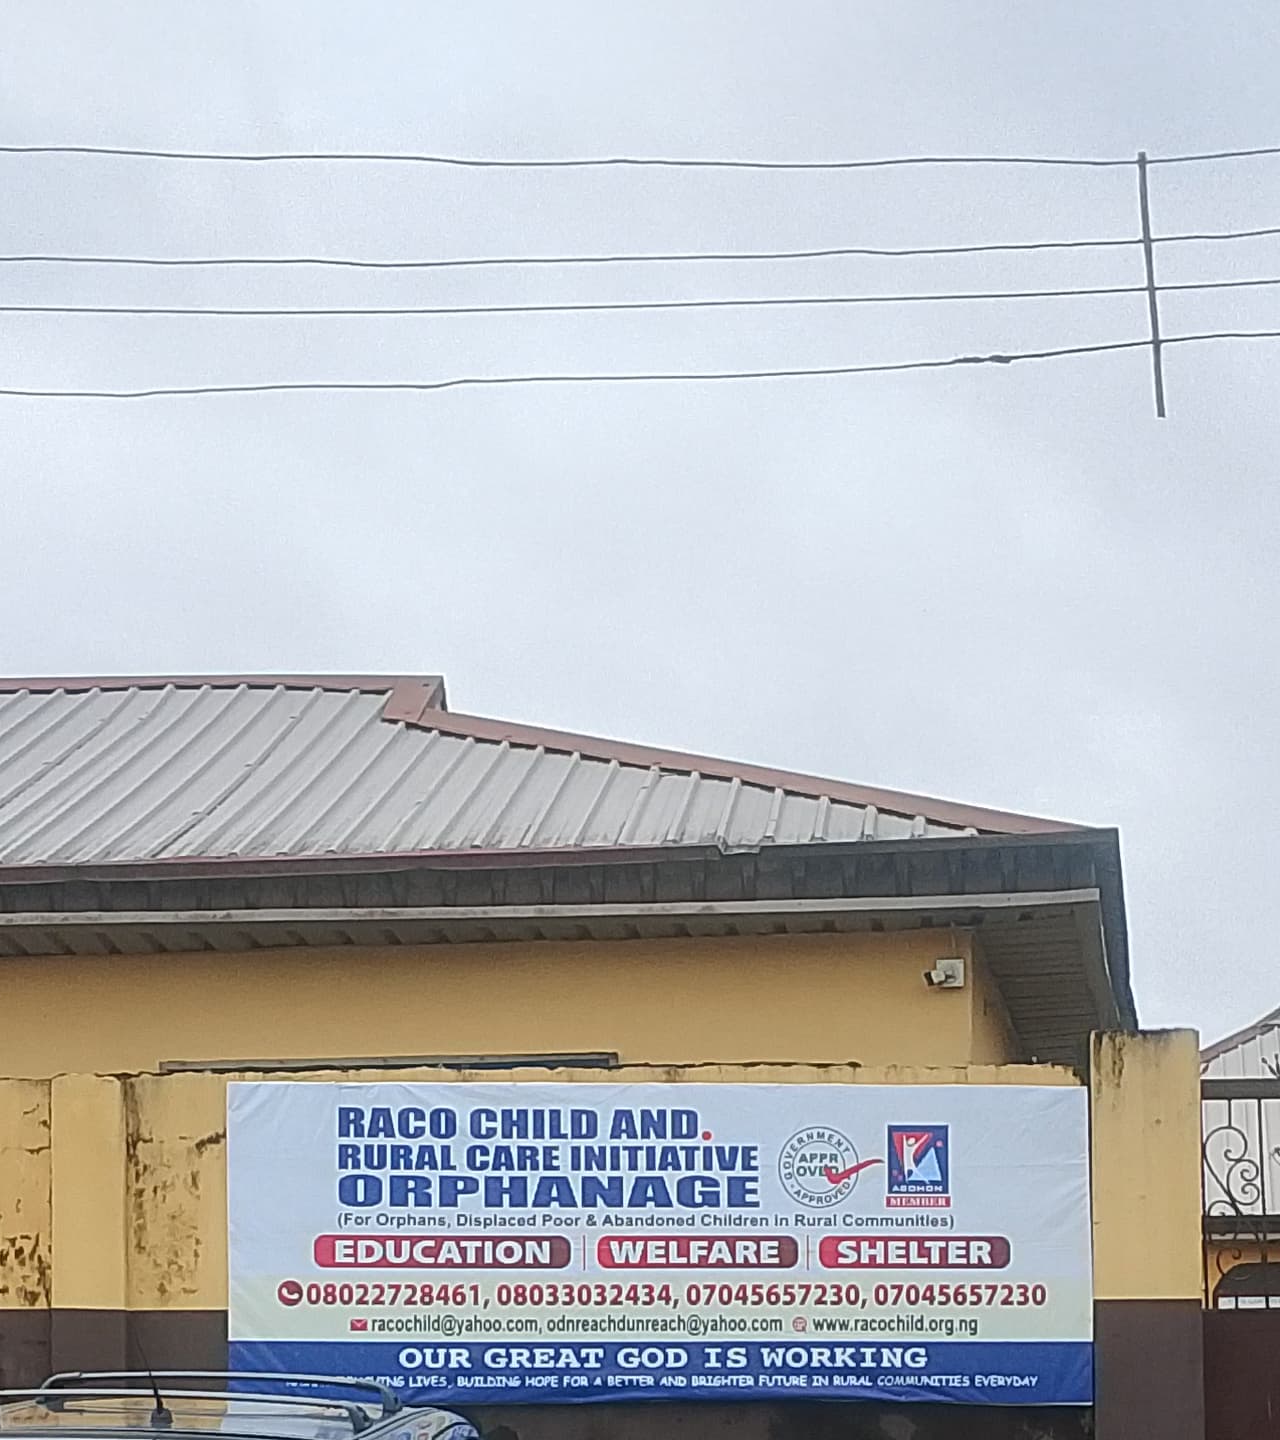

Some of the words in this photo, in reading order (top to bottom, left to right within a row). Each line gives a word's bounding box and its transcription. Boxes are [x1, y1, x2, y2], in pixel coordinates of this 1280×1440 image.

[337, 1106, 457, 1140] RACO
[469, 1107, 598, 1140] CHILD
[337, 1144, 457, 1171] RURAL
[466, 1144, 561, 1171] CARE
[569, 1145, 760, 1171] INITIATIVE
[783, 1131, 851, 1181] GOVERNMENT
[798, 1153, 840, 1164] APPR
[337, 1174, 761, 1208] ORPHANAGE
[889, 1197, 948, 1207] MEMBER
[337, 1213, 371, 1229] (For
[375, 1213, 452, 1230] Orphans,
[456, 1213, 537, 1229] Displaced
[541, 1214, 581, 1228] Poor
[585, 1214, 598, 1228] &
[602, 1214, 696, 1228] Abandoned
[700, 1214, 769, 1227] Children
[794, 1214, 838, 1227] Rural
[842, 1213, 955, 1230] Communities)
[333, 1239, 552, 1265] EDUCATION
[608, 1240, 780, 1265] WELFARE
[836, 1240, 992, 1265] SHELTER
[306, 1283, 490, 1309] 08022728461,
[496, 1283, 679, 1309] 08033032434,
[686, 1284, 868, 1309] 07045657230,
[873, 1284, 1047, 1307] 07045657230
[371, 1315, 543, 1336] racochild@yahoo.com,
[812, 1316, 978, 1336] www.racochild.org.ng
[398, 1347, 472, 1369] OUR
[483, 1347, 604, 1369] GREAT
[616, 1347, 688, 1369] GOD
[703, 1347, 748, 1369] IS
[761, 1347, 928, 1369] WORKING
[408, 1375, 453, 1389] LIVES,
[456, 1375, 522, 1388] BUILDING
[525, 1375, 559, 1387] HOPE
[563, 1375, 589, 1387] FOR
[593, 1375, 603, 1387] A
[607, 1375, 655, 1387] BETTER
[658, 1375, 687, 1387] AND
[691, 1375, 755, 1388] BRIGHTER
[758, 1375, 808, 1387] FUTURE
[811, 1375, 829, 1387] IN
[832, 1375, 873, 1387] RURAL
[877, 1375, 970, 1388] COMMUNITIES
[974, 1375, 1038, 1388] EVERYDAY
